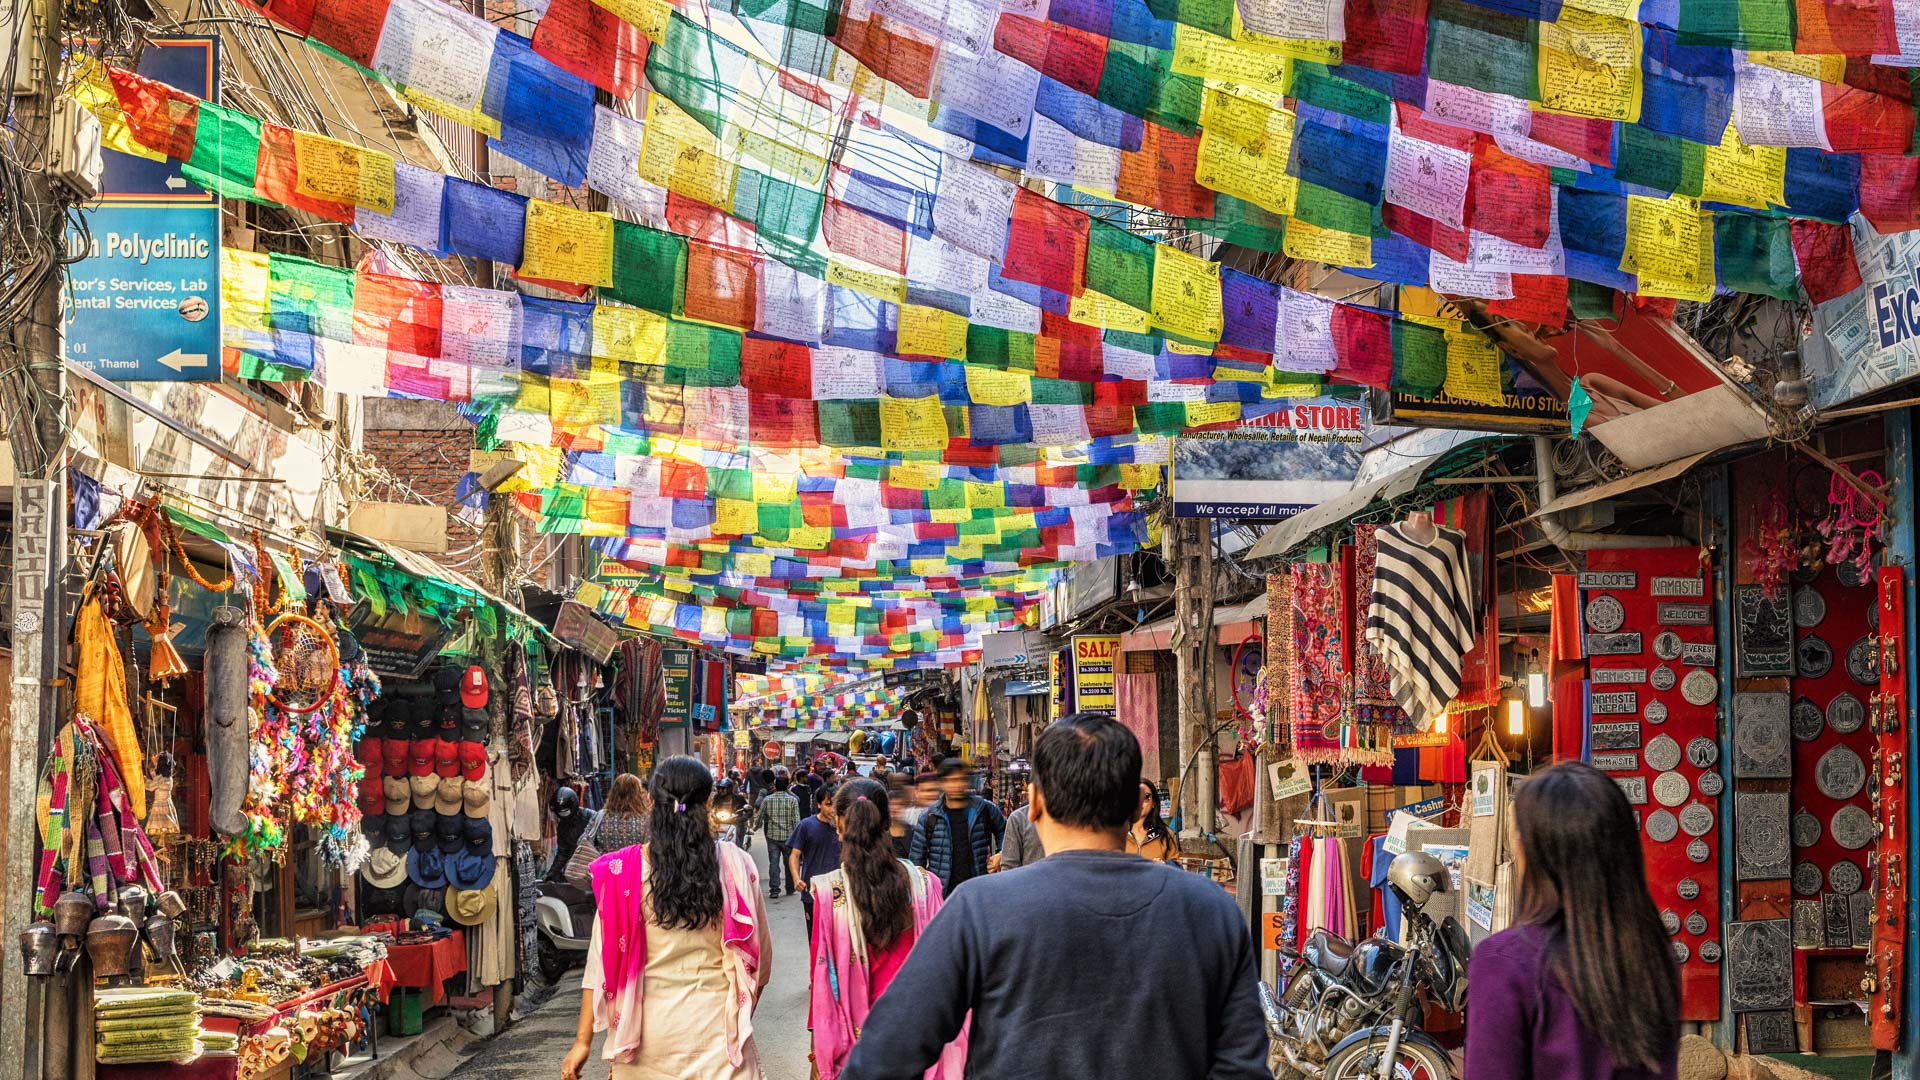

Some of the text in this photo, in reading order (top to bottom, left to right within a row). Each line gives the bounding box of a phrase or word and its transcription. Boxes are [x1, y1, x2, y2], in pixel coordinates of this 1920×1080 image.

[106, 232, 209, 265] Polyclinic
[66, 278, 208, 293] tor's Services, Lab
[115, 296, 178, 309] Services
[1873, 266, 1920, 349] Exc
[73, 342, 87, 354] 01
[98, 358, 139, 369] Thamel
[1537, 397, 1570, 413] STIC
[1295, 405, 1361, 430] STORE
[1270, 433, 1298, 442] Retailer
[1300, 433, 1307, 443] of
[1309, 434, 1331, 444] Nepali
[1332, 434, 1362, 444] Products
[1196, 504, 1214, 514] We
[1217, 505, 1260, 516] accept
[1262, 506, 1276, 515] all
[1652, 580, 1703, 595] NAMASTE
[1664, 609, 1706, 619] WELCOME
[1683, 644, 1716, 653] EVEREST
[1592, 693, 1635, 704] NAMASTE
[1599, 704, 1629, 713] NEPAL
[1592, 724, 1639, 732] NAMASTE
[1406, 735, 1449, 745] Cashmere
[1594, 758, 1633, 766] NAMASTE
